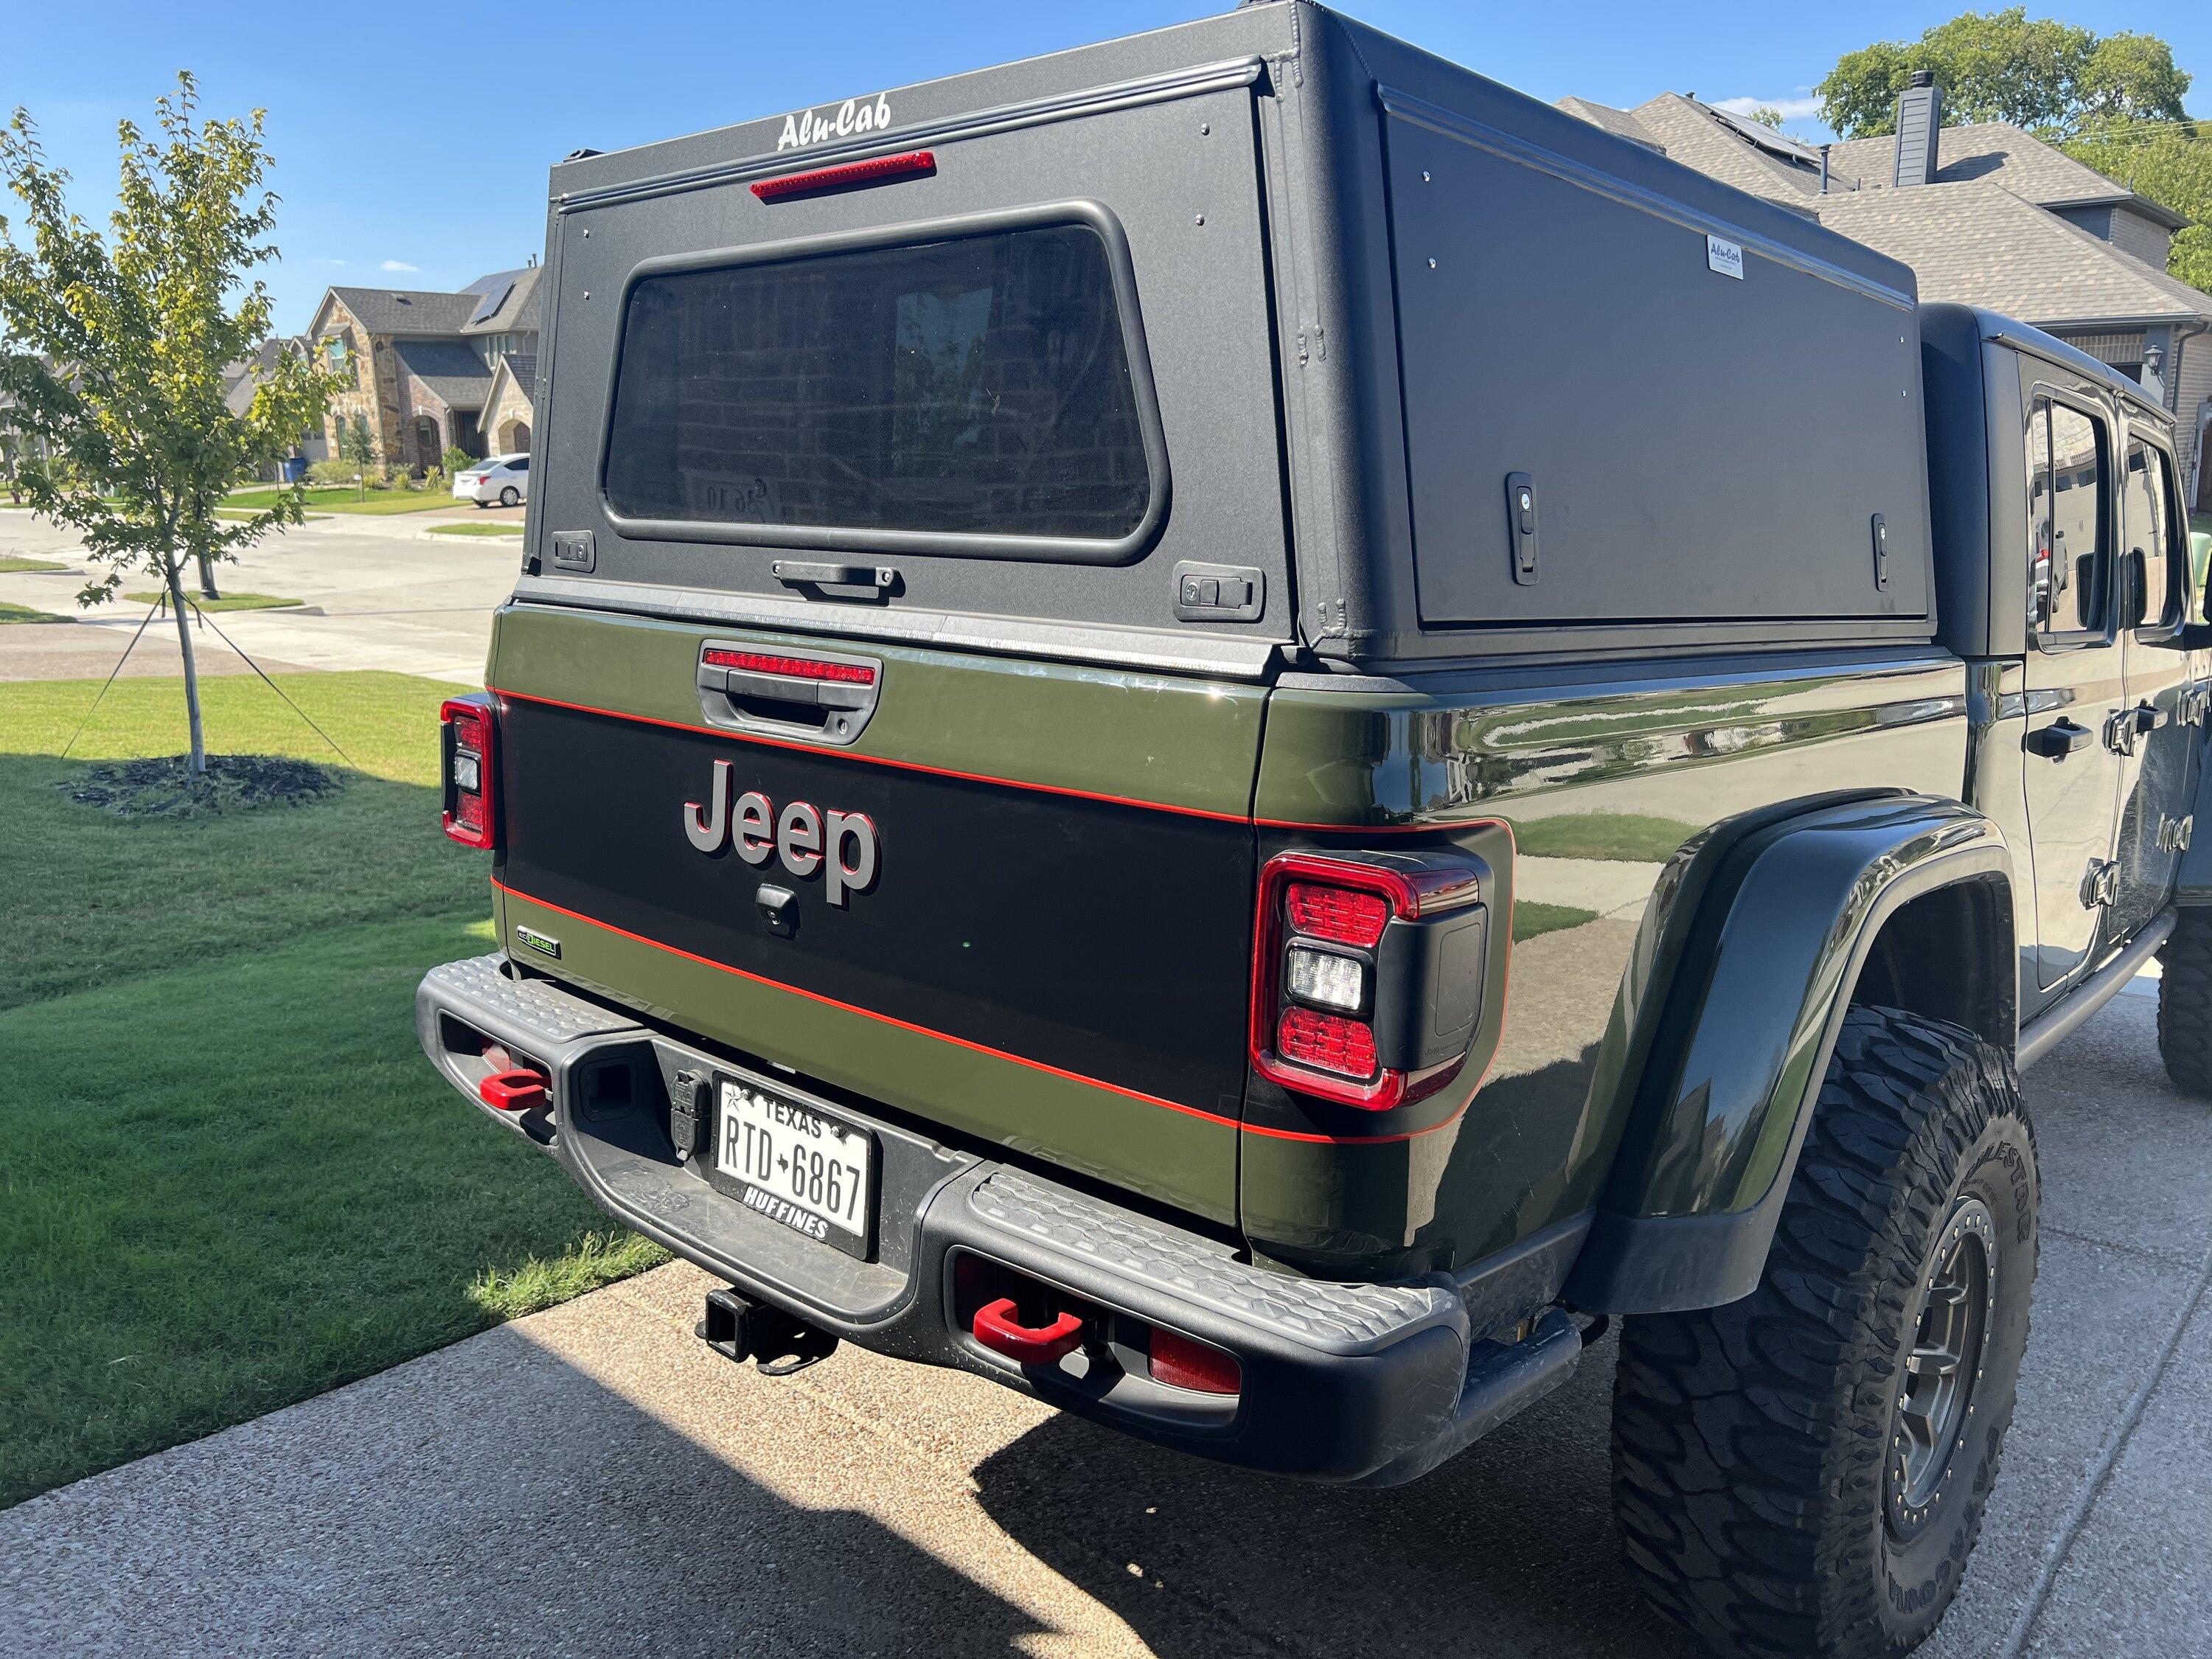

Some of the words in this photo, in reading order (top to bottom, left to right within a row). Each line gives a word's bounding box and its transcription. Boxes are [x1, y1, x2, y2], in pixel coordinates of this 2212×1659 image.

[777, 91, 891, 151] Alu-Cab
[1711, 243, 1740, 263] Alu-Cab
[684, 759, 880, 908] Jeep
[763, 1096, 821, 1138] TEXAS
[743, 1185, 829, 1240] HUFFINES
